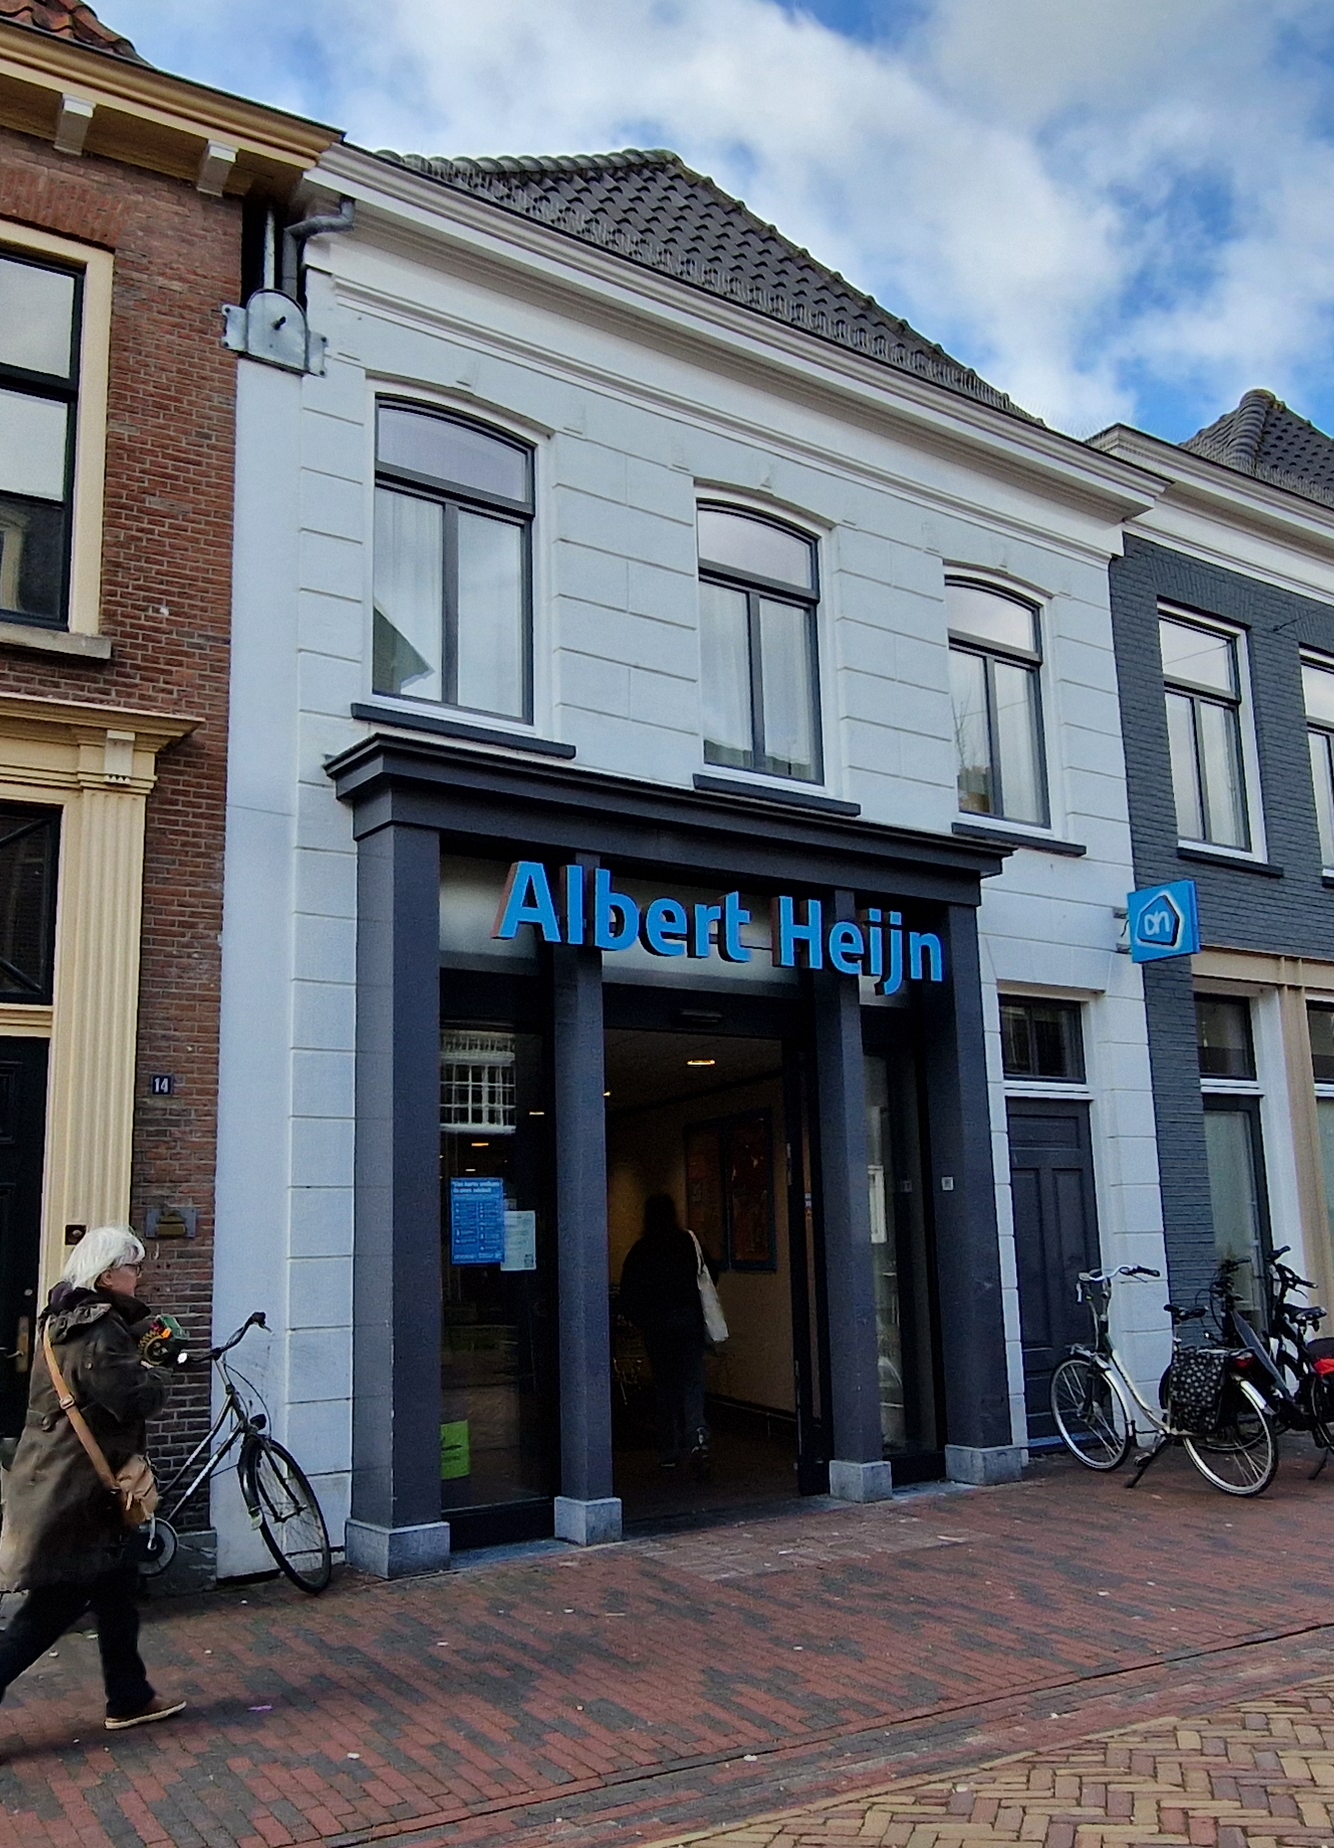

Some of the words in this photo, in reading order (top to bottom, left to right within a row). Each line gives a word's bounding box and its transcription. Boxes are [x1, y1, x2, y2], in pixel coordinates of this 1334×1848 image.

[492, 860, 752, 963] Albert
[773, 895, 943, 996] Heijn
[154, 1077, 169, 1093] 14
